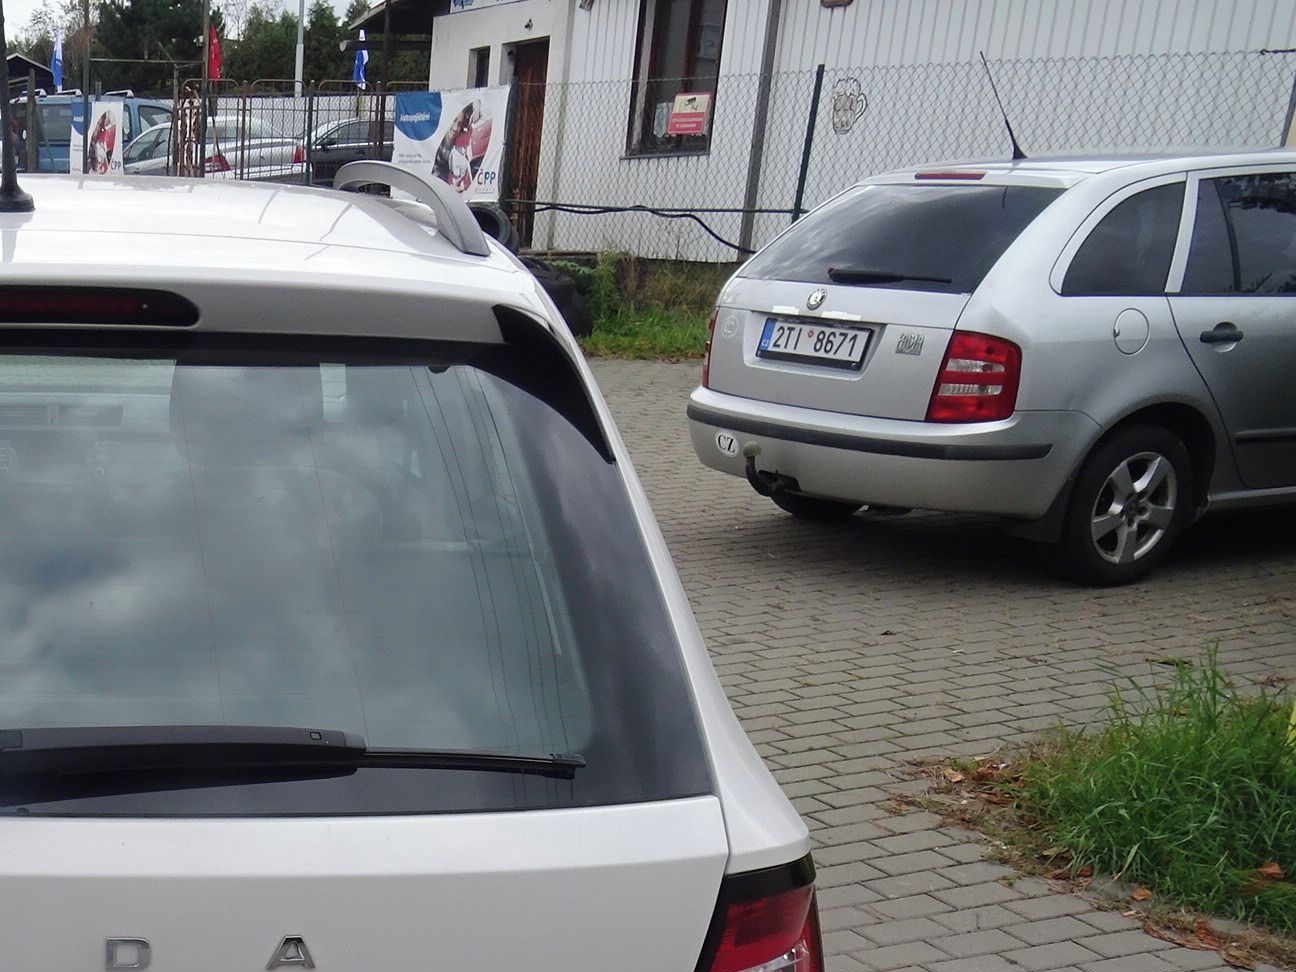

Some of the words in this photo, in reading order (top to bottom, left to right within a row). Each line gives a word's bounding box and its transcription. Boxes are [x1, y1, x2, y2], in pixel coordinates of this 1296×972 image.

[477, 169, 496, 185] ČPP
[773, 326, 803, 350] 2TI
[813, 330, 858, 357] 8671
[717, 434, 736, 453] CZ
